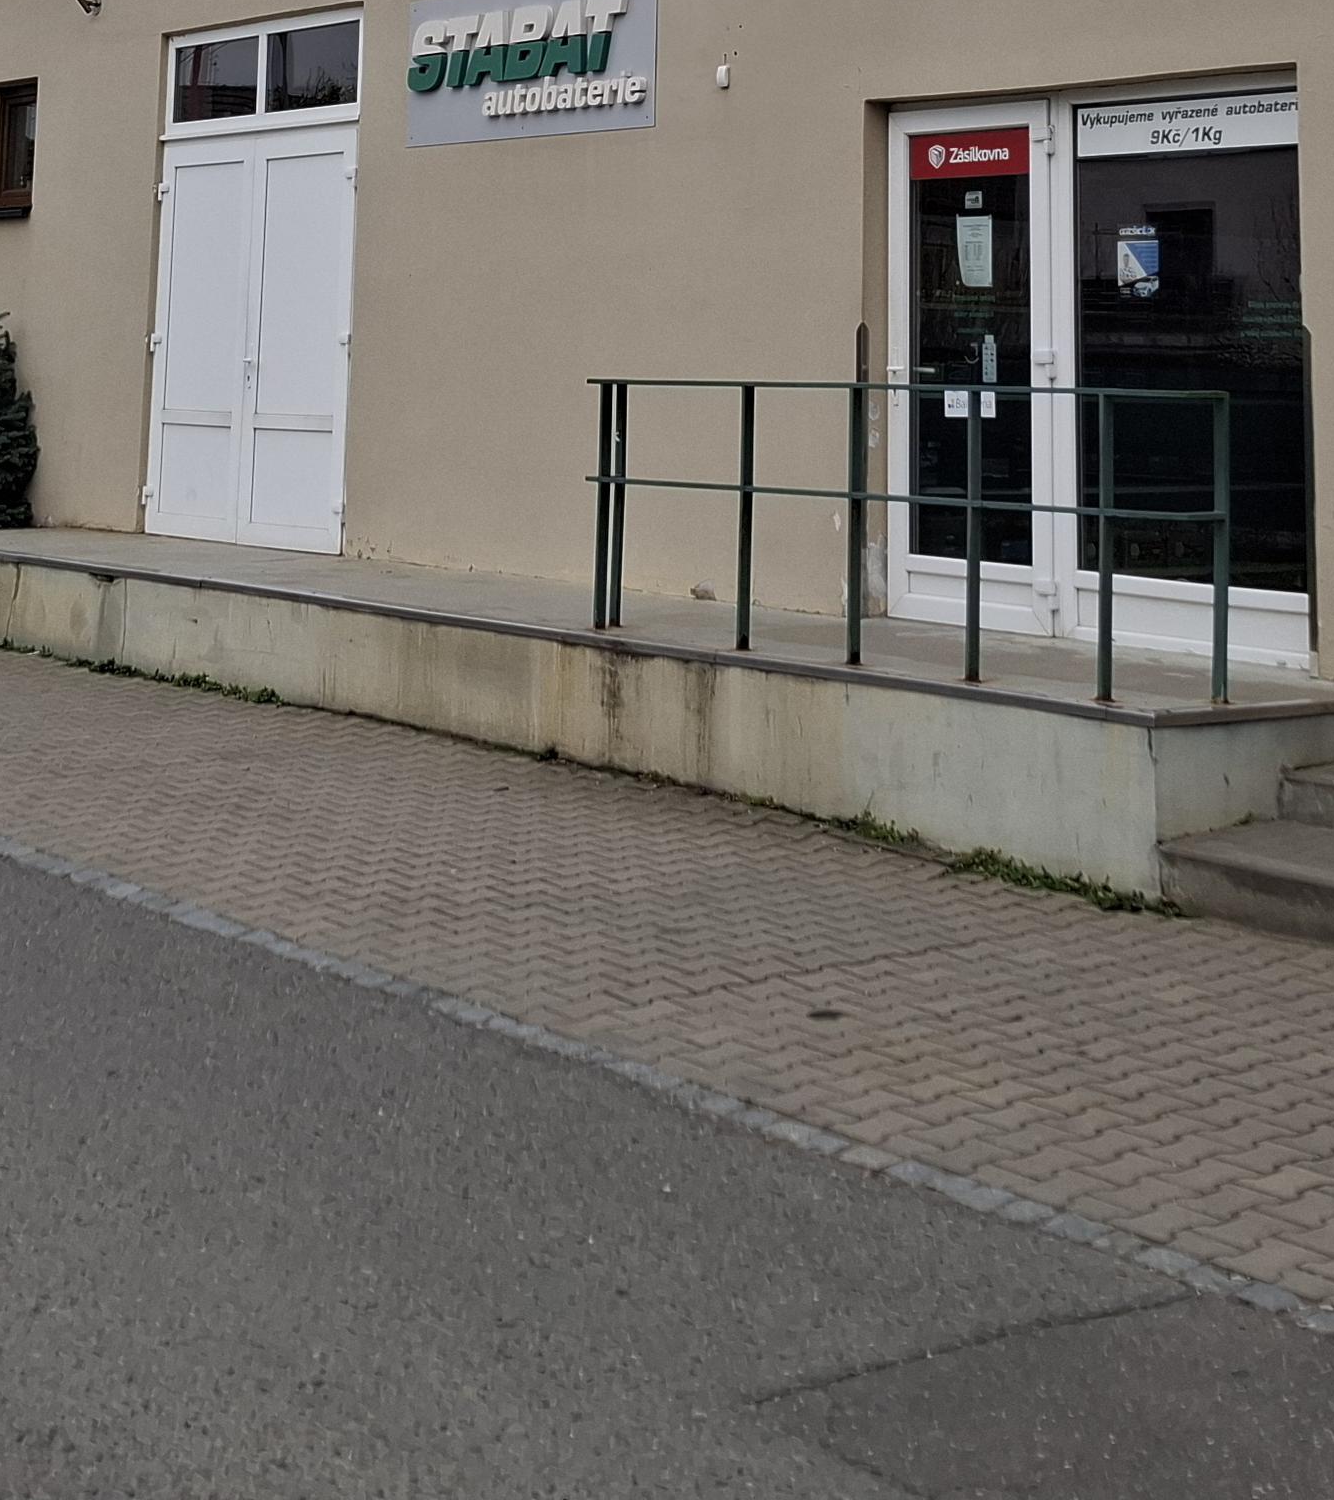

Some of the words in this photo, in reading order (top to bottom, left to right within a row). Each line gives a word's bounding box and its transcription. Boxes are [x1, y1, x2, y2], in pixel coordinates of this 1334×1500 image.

[482, 70, 647, 117] autobaterie
[1081, 111, 1154, 129] Vykupujeme
[1161, 103, 1219, 123] vyřazené
[1150, 126, 1223, 148] 9Kč/1Kg
[949, 145, 1009, 163] Zásilkovna
